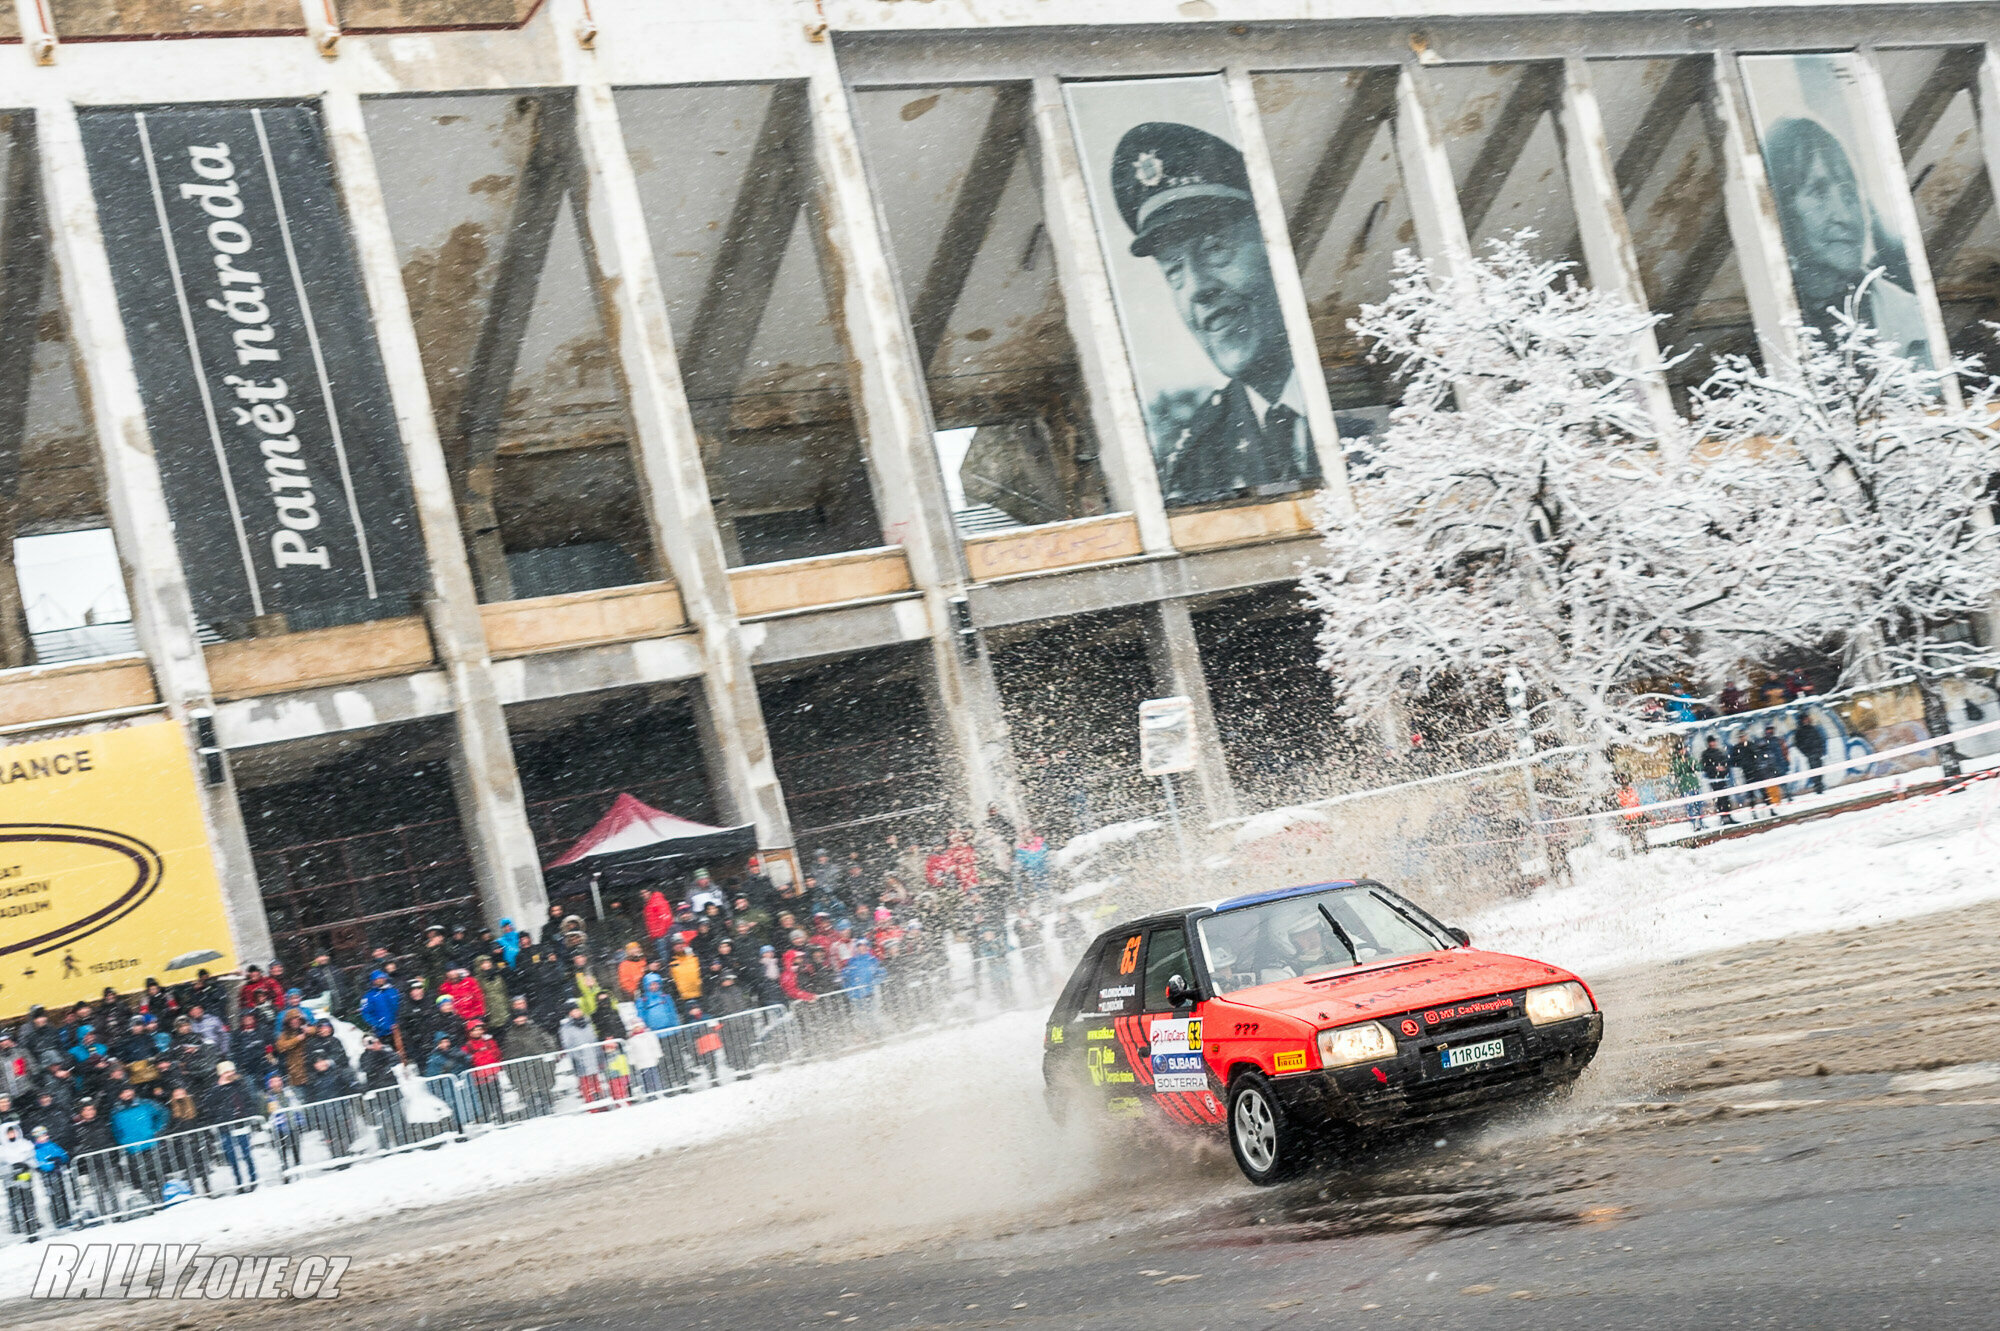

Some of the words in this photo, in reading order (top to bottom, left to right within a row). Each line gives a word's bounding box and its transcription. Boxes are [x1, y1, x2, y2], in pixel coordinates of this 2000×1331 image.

[180, 142, 282, 365] národa
[224, 375, 331, 569] Paměť
[1120, 935, 1142, 976] 63
[1188, 1021, 1202, 1050] 63
[1168, 1057, 1202, 1070] SUBARU
[1277, 1054, 1303, 1067] PIRELLI
[1451, 1048, 1473, 1064] 11R
[1474, 1041, 1502, 1059] 0459
[1157, 1078, 1205, 1088] SOLTERRA
